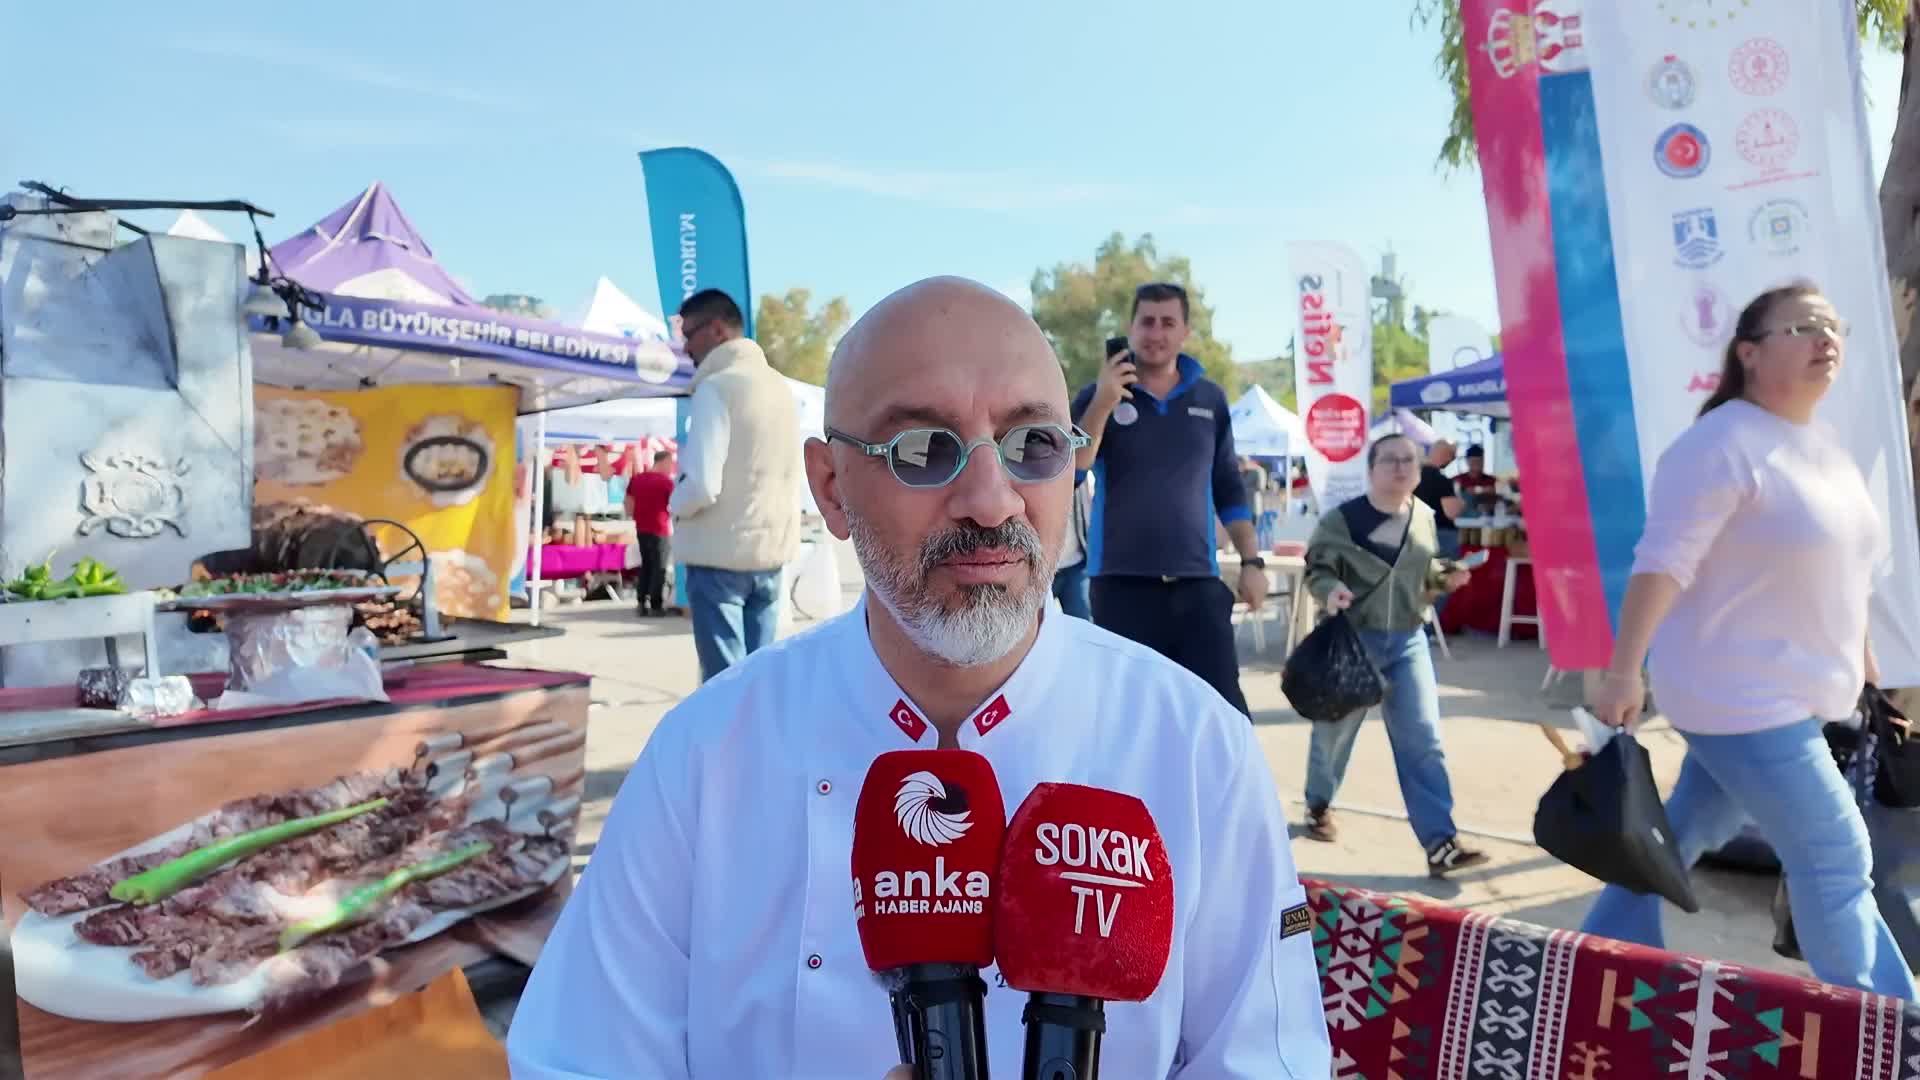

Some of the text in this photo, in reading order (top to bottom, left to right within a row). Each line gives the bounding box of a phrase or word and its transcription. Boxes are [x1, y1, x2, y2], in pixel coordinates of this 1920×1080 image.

[362, 307, 511, 345] BÜYÜKŞEHİR
[515, 328, 629, 365] BELEDİYESİ
[874, 856, 990, 898] anka
[875, 900, 929, 914] HABER
[932, 900, 983, 914] AJANS
[1071, 885, 1122, 938] TV
